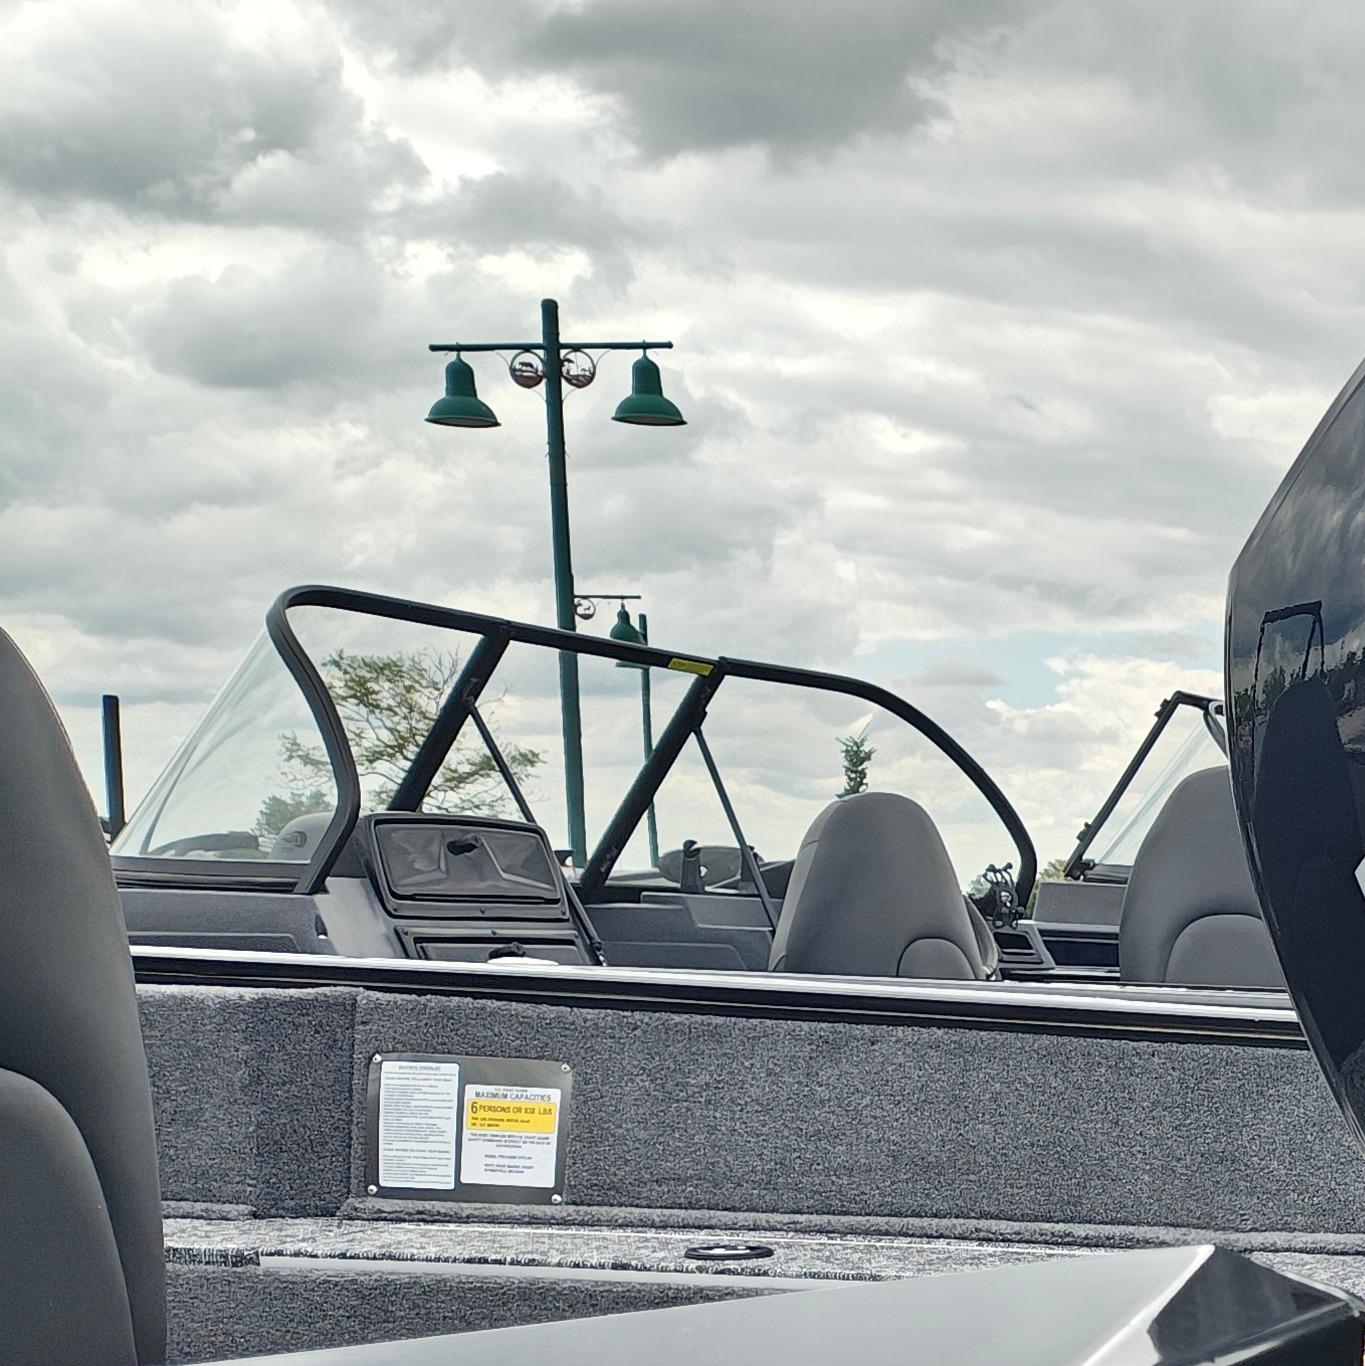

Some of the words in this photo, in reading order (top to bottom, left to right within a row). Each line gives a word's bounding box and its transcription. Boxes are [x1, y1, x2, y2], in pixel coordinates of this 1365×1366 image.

[471, 1101, 478, 1114] 6
[479, 1104, 511, 1113] PERSONS
[512, 1106, 522, 1114] OR
